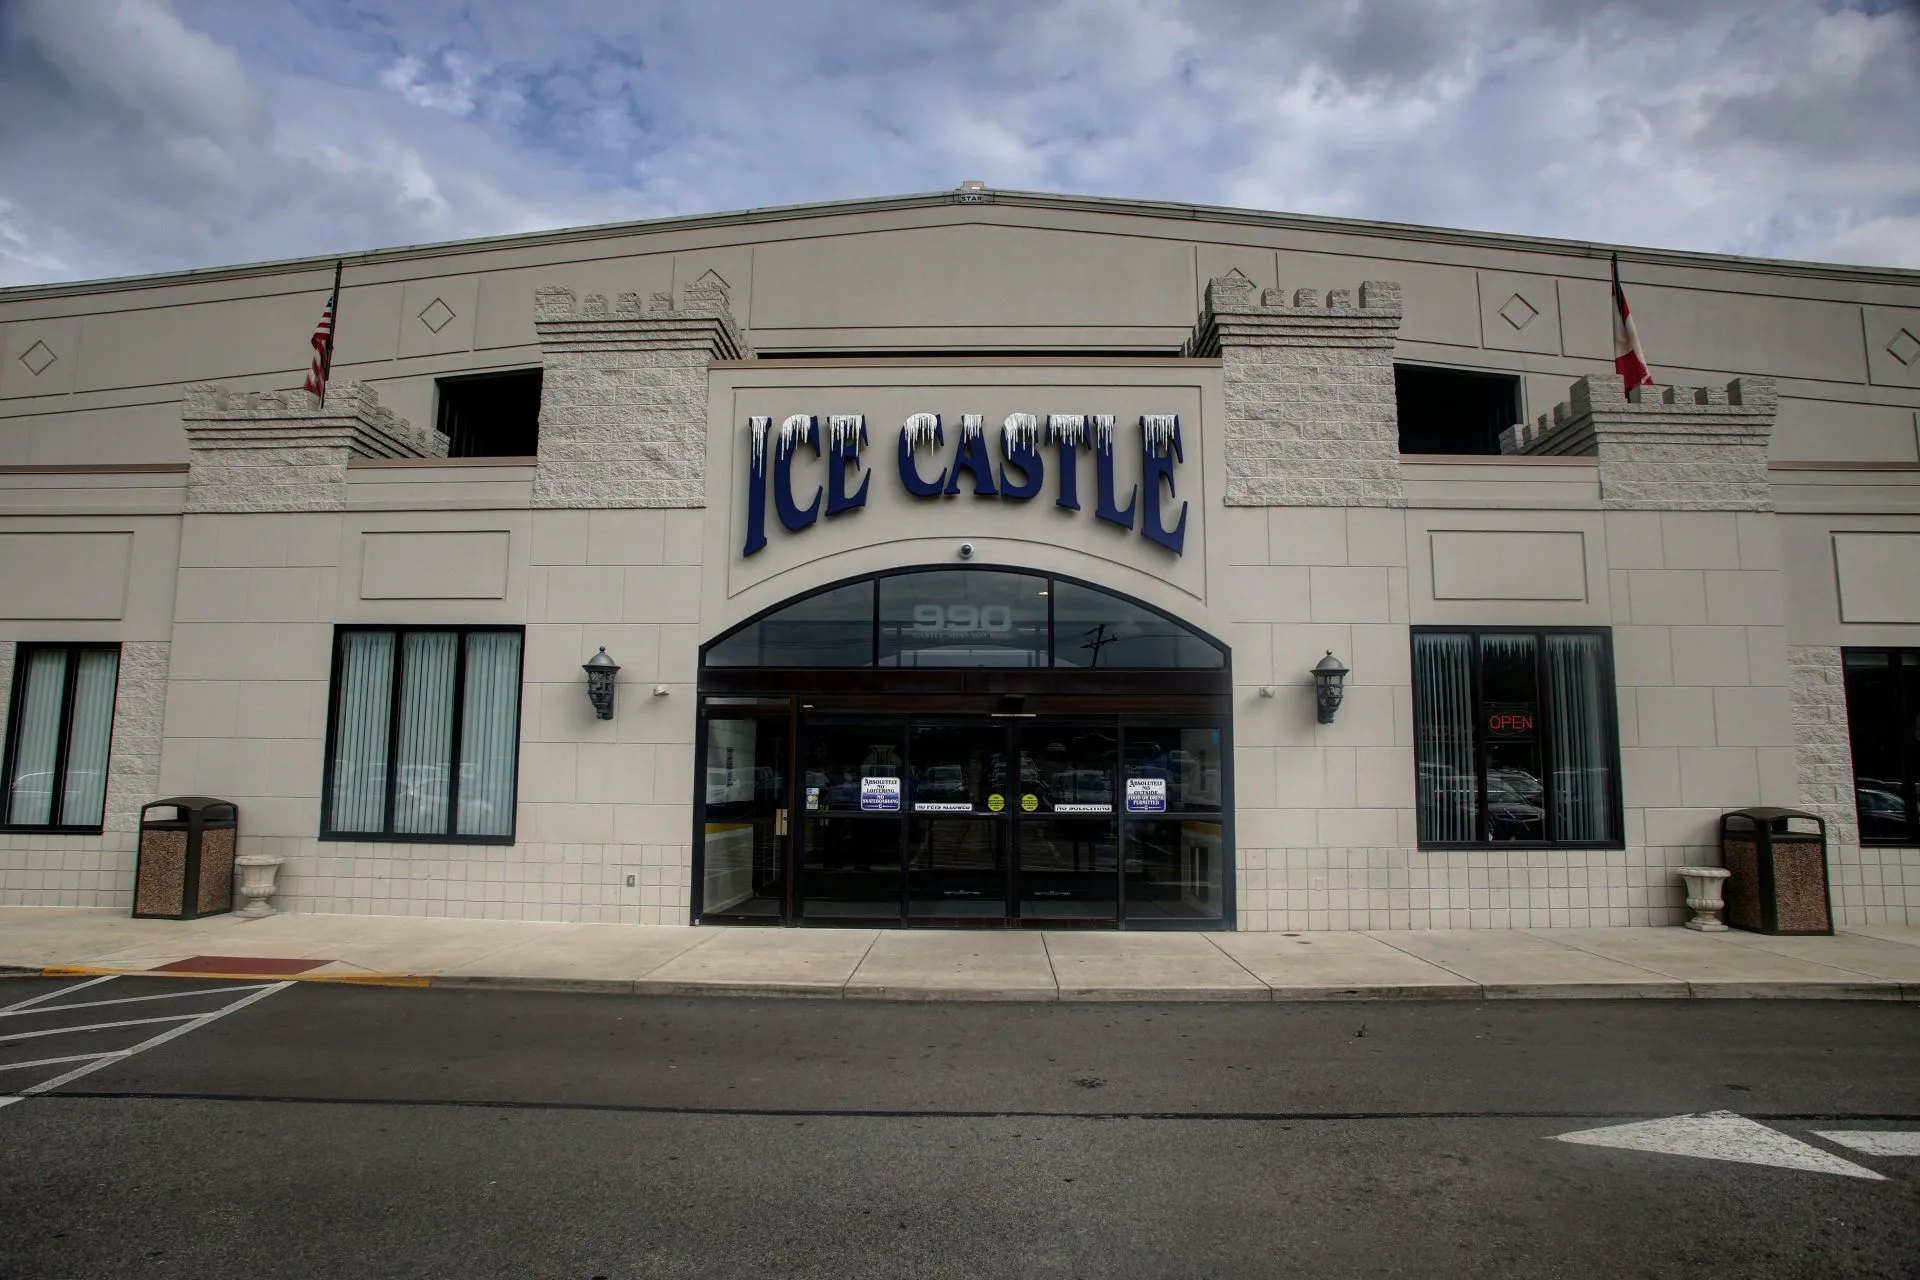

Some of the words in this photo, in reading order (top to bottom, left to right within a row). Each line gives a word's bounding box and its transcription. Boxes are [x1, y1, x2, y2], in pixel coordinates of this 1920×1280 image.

[743, 414, 872, 557] ICE
[897, 413, 1188, 558] CASTLE
[913, 605, 1011, 631] 990
[1489, 715, 1533, 729] OPEN
